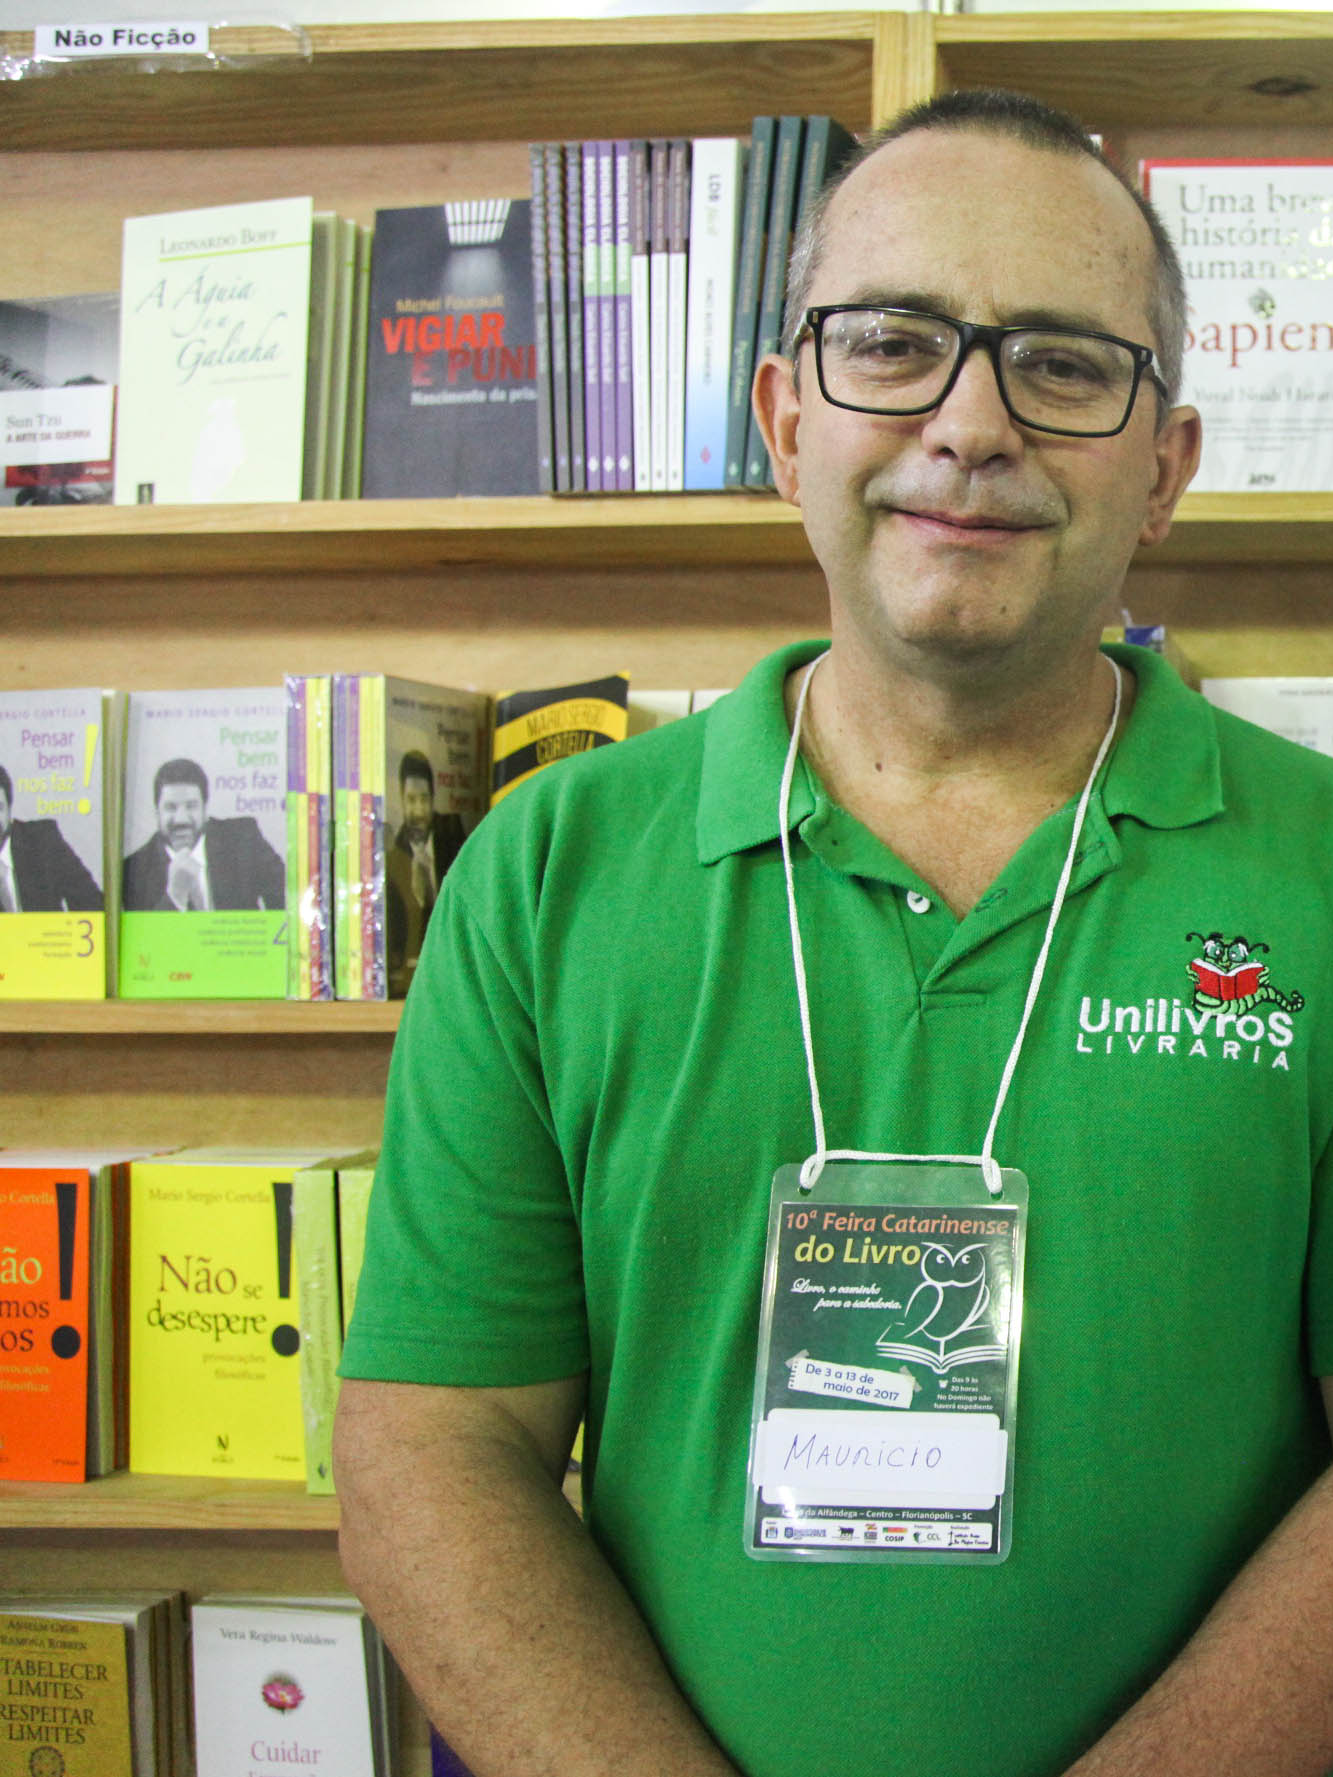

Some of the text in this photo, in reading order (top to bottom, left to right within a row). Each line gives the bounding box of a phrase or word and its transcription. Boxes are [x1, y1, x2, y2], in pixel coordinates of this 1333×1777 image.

[53, 28, 196, 51] Não Ficção
[1178, 183, 1256, 214] Uma
[1180, 217, 1301, 248] história
[381, 312, 505, 354] VIGIAR
[176, 311, 288, 386] Galinha
[411, 350, 434, 387] E
[448, 343, 537, 385] PUNI
[21, 729, 75, 748] Pensar
[219, 726, 280, 747] Pensar
[38, 751, 75, 769] bem
[236, 748, 280, 768] bem
[17, 773, 76, 793] nos faz
[215, 770, 280, 792] nos faz
[37, 795, 75, 815] bem
[235, 793, 278, 814] bem
[76, 919, 95, 958] 3
[1076, 1033, 1290, 1071] LIVRARIA
[149, 1188, 271, 1206] Mario Sergio Cortella
[786, 1209, 1009, 1235] 10ª Feira Catarinense
[794, 1235, 921, 1265] do Livro
[0, 1247, 43, 1286] ão
[159, 1253, 263, 1300] Não se
[838, 1284, 881, 1295] caminho
[813, 1297, 841, 1313] para
[146, 1299, 267, 1343] desespere
[805, 1363, 875, 1385] De 3 a 13 de
[823, 1380, 900, 1401] maio de 2017
[817, 1508, 858, 1519] Alfândega
[866, 1510, 894, 1519] Centro
[902, 1511, 954, 1521] Florianópolis
[961, 1512, 973, 1520] SC
[219, 1627, 289, 1647] Vera Regina
[1, 1658, 108, 1681] TABELECER
[7, 1679, 85, 1701] LIMITES
[0, 1703, 95, 1726] RESPEITAR
[8, 1723, 86, 1745] LIMITES
[250, 1740, 322, 1766] Cuidar
